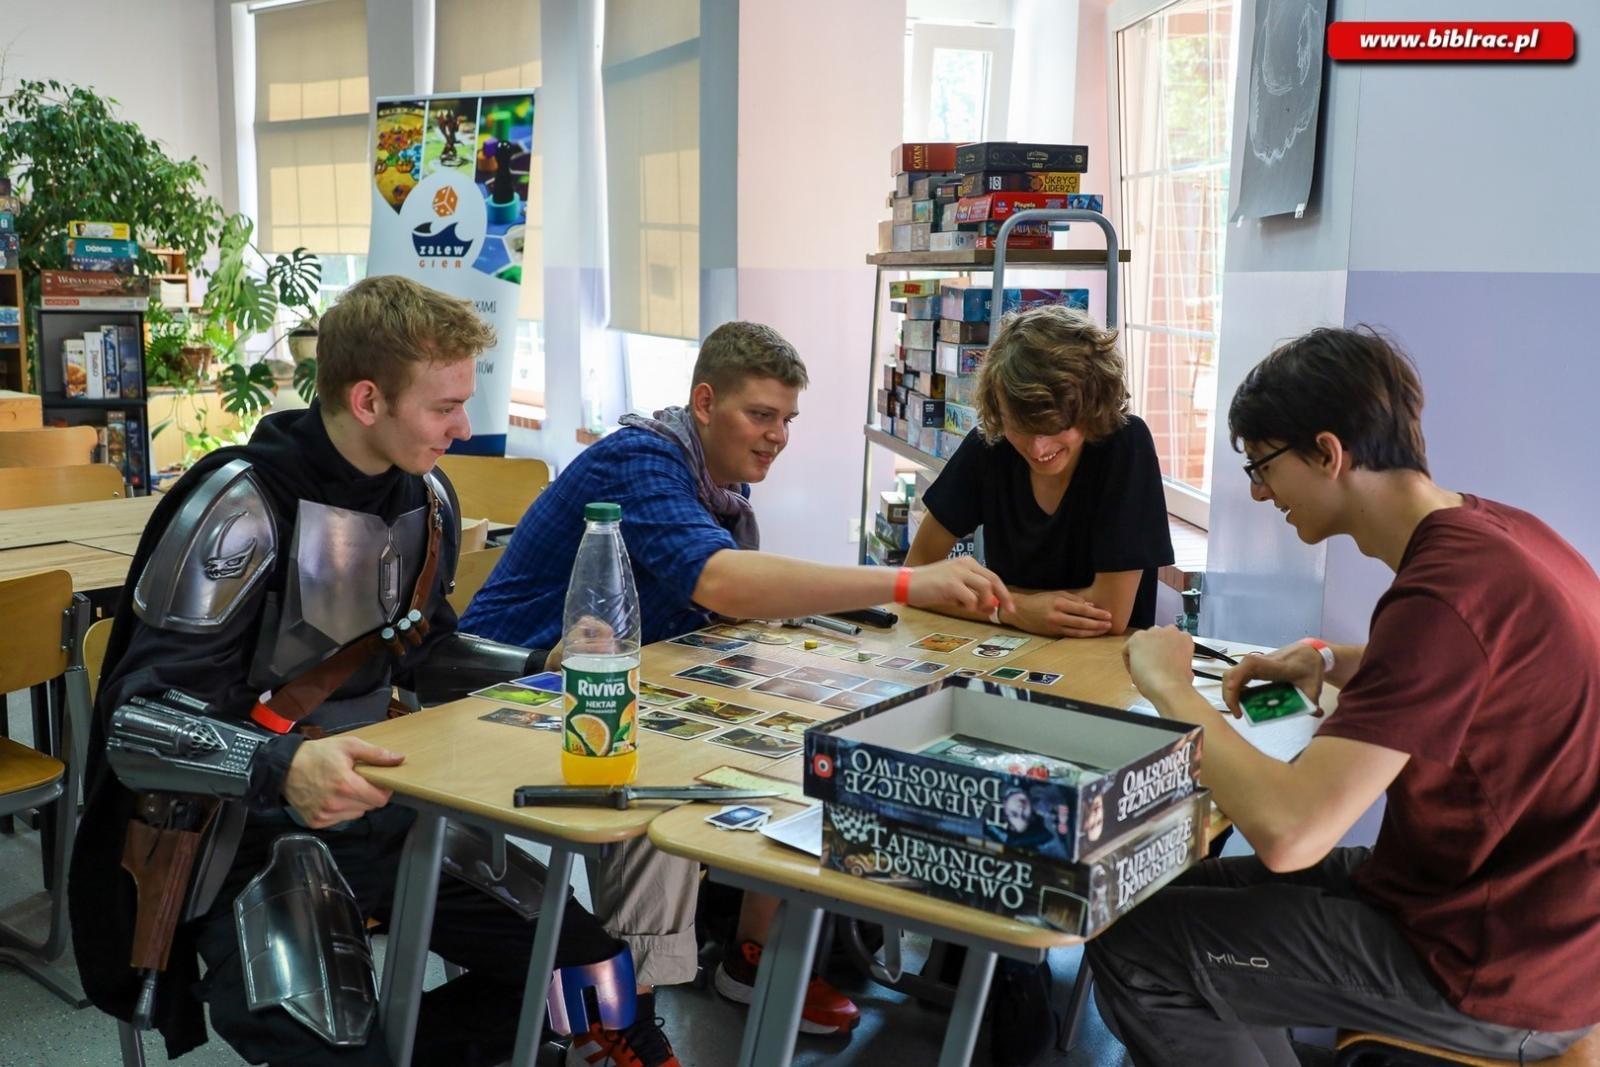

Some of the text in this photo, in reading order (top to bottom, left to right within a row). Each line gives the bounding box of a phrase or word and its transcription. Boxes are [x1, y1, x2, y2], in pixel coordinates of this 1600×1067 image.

[913, 144, 922, 169] CATAN
[1044, 175, 1077, 184] UKRYCI
[1044, 184, 1076, 193] LIDERZY
[475, 300, 496, 313] KAMI
[578, 679, 625, 697] Riviva
[585, 700, 617, 708] NEKTAR
[851, 748, 1002, 801] DOMOSTWO
[1117, 763, 1191, 822] TAJEMNICZE
[1123, 741, 1193, 796] DOMOSTWO
[844, 769, 1009, 829] TAJEMNICZE
[870, 824, 1034, 889] TAJEMNICZE
[1116, 816, 1192, 885] TAJEMNICZE
[1117, 842, 1188, 911] DOMOSTWO
[874, 849, 1024, 909] DOMOSTWO
[1207, 951, 1269, 968] MILO
